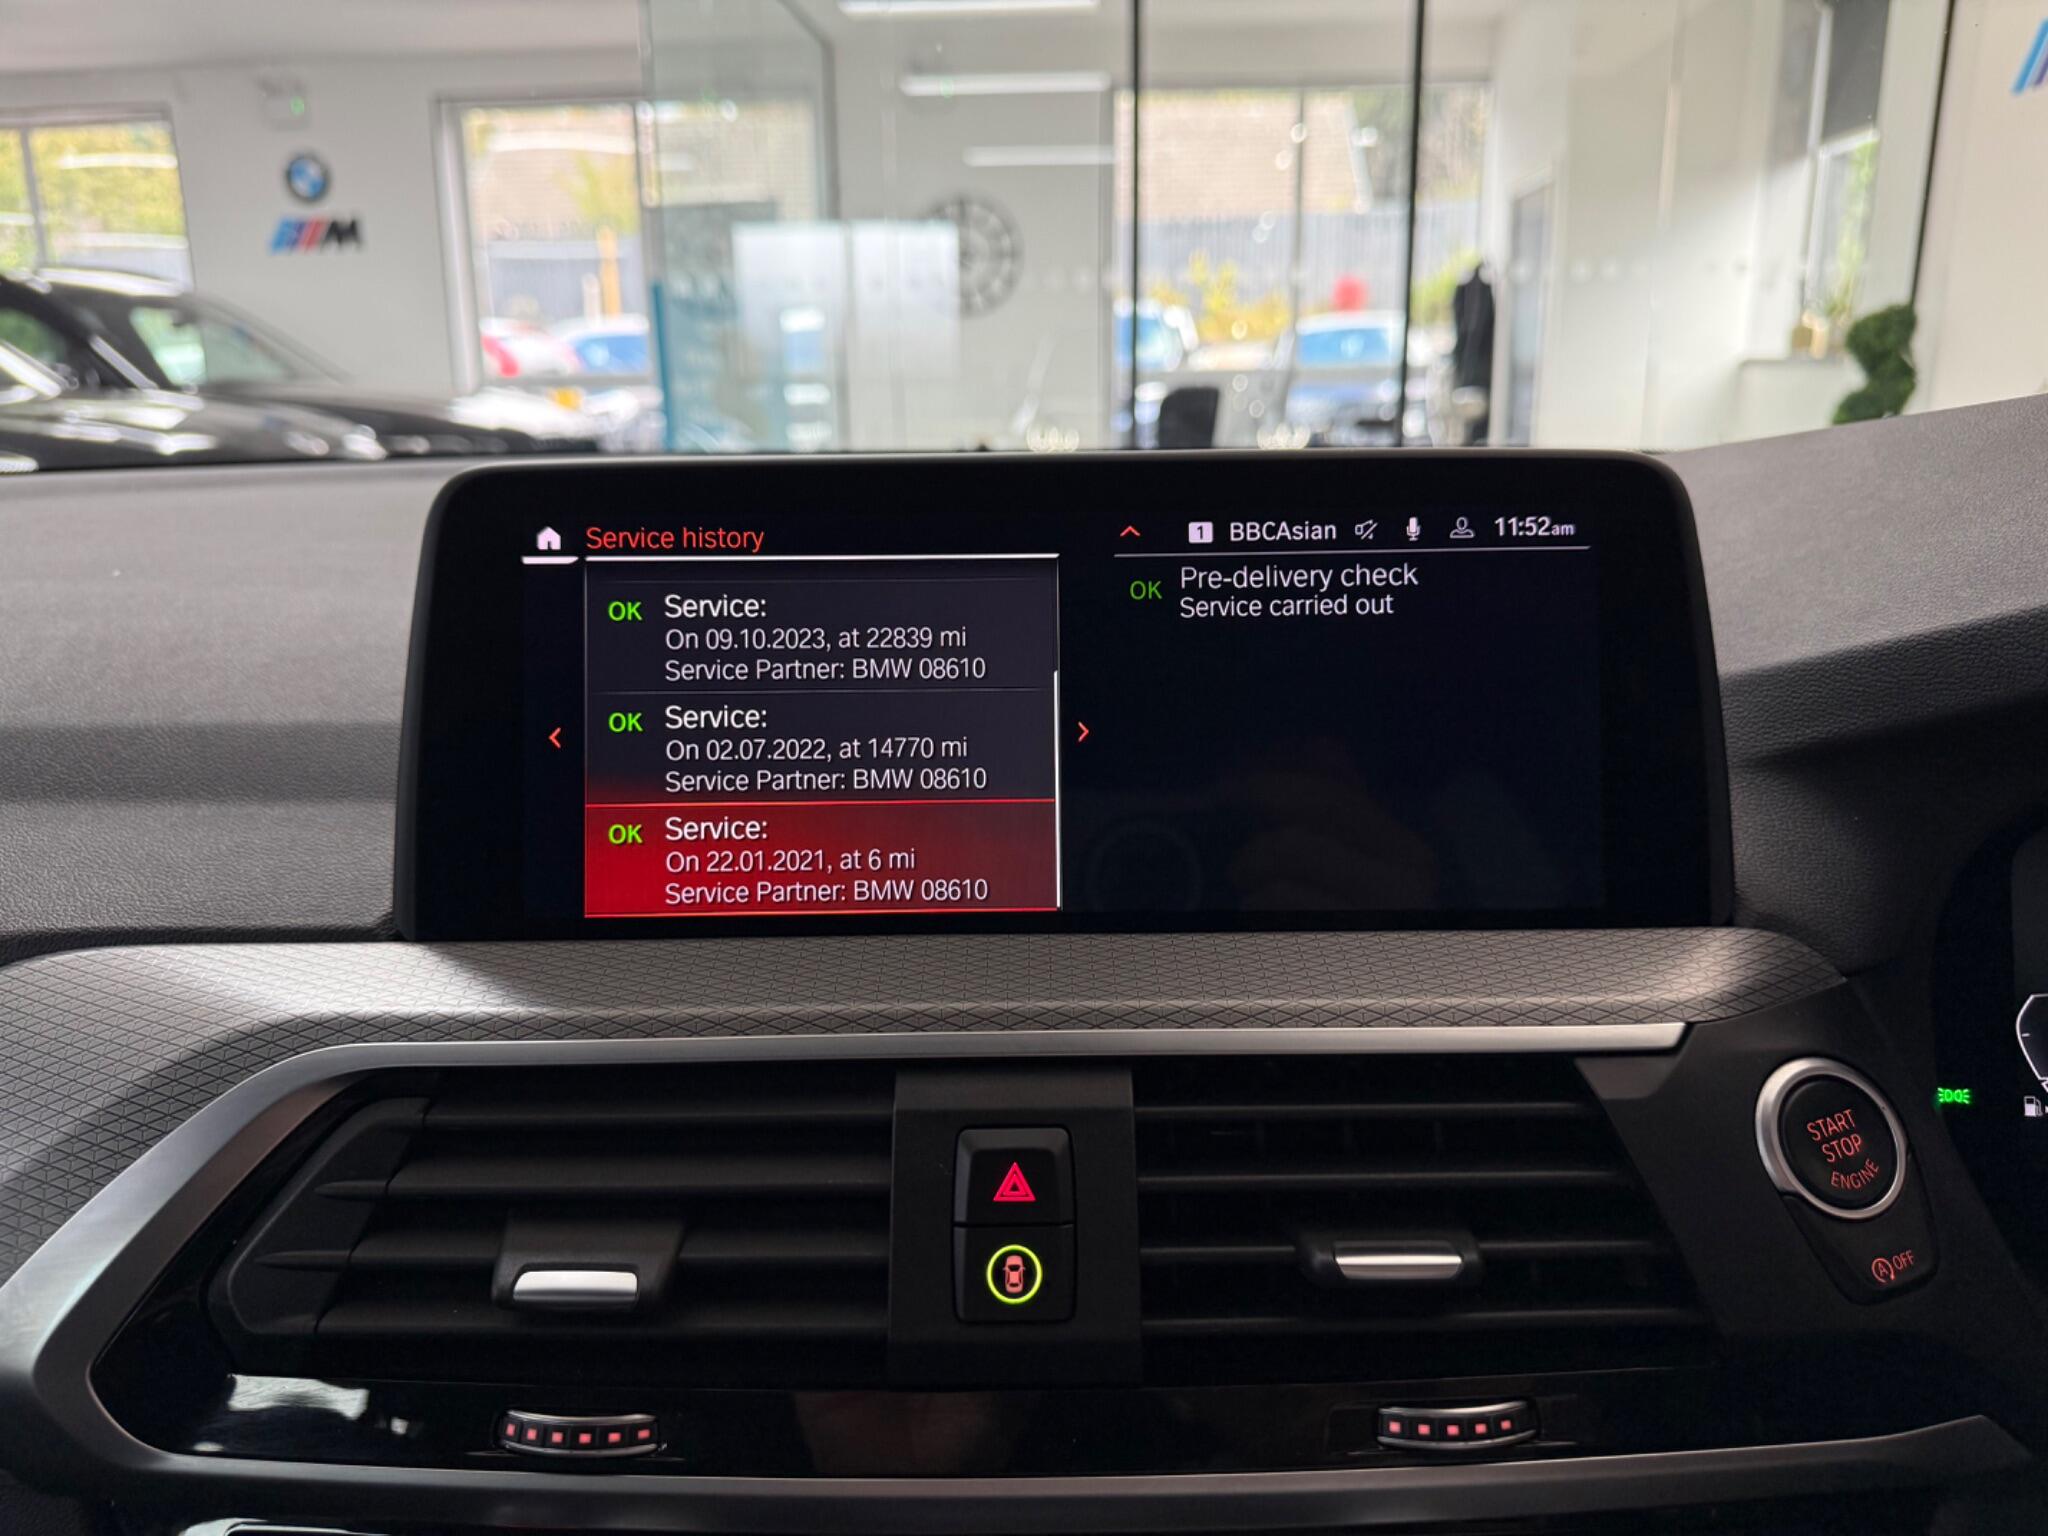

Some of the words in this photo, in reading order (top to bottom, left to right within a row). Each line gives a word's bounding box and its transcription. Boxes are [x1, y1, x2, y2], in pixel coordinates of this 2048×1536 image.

[586, 527, 675, 550] Service
[683, 527, 764, 553] history
[1230, 520, 1337, 542] BBCAsian
[1129, 580, 1162, 600] OK
[1181, 564, 1333, 593] Pre-delivery
[1340, 562, 1419, 587] check
[608, 601, 642, 621] OK
[664, 594, 766, 619] Service:
[1180, 595, 1263, 619] Service
[1269, 593, 1348, 617] carried
[1355, 594, 1394, 615] out
[665, 628, 699, 650] On
[705, 627, 831, 652] 09.10.2023,
[838, 628, 860, 649] at
[866, 626, 933, 649] 22839
[940, 626, 966, 647] mi
[665, 659, 749, 682] Service
[756, 658, 845, 680] Partner:
[852, 658, 913, 679] BMW
[919, 657, 986, 679] 08610
[608, 712, 643, 732] OK
[665, 704, 767, 729] Service:
[666, 739, 699, 761] On
[706, 738, 832, 763] 02.07.2022,
[839, 738, 861, 759] at
[868, 736, 934, 759] 14770
[941, 736, 967, 757] mi
[665, 770, 750, 793] Service
[756, 769, 846, 791] Partner:
[853, 768, 914, 789] BMW
[920, 767, 987, 790] 08610
[608, 824, 642, 844] OK
[665, 816, 767, 841] Service:
[666, 851, 700, 873] On
[706, 849, 833, 874] 22.01.2021,
[839, 849, 862, 870] at
[868, 848, 882, 871] 6
[888, 847, 915, 869] mi
[665, 881, 750, 905] Service
[757, 881, 846, 903] Partner:
[854, 879, 915, 901] BMW
[921, 878, 988, 901] 08610
[1806, 1109, 1856, 1142] START
[1821, 1133, 1863, 1163] STOP
[1831, 1158, 1879, 1190] ENGINE
[1894, 1250, 1914, 1271] OFF
